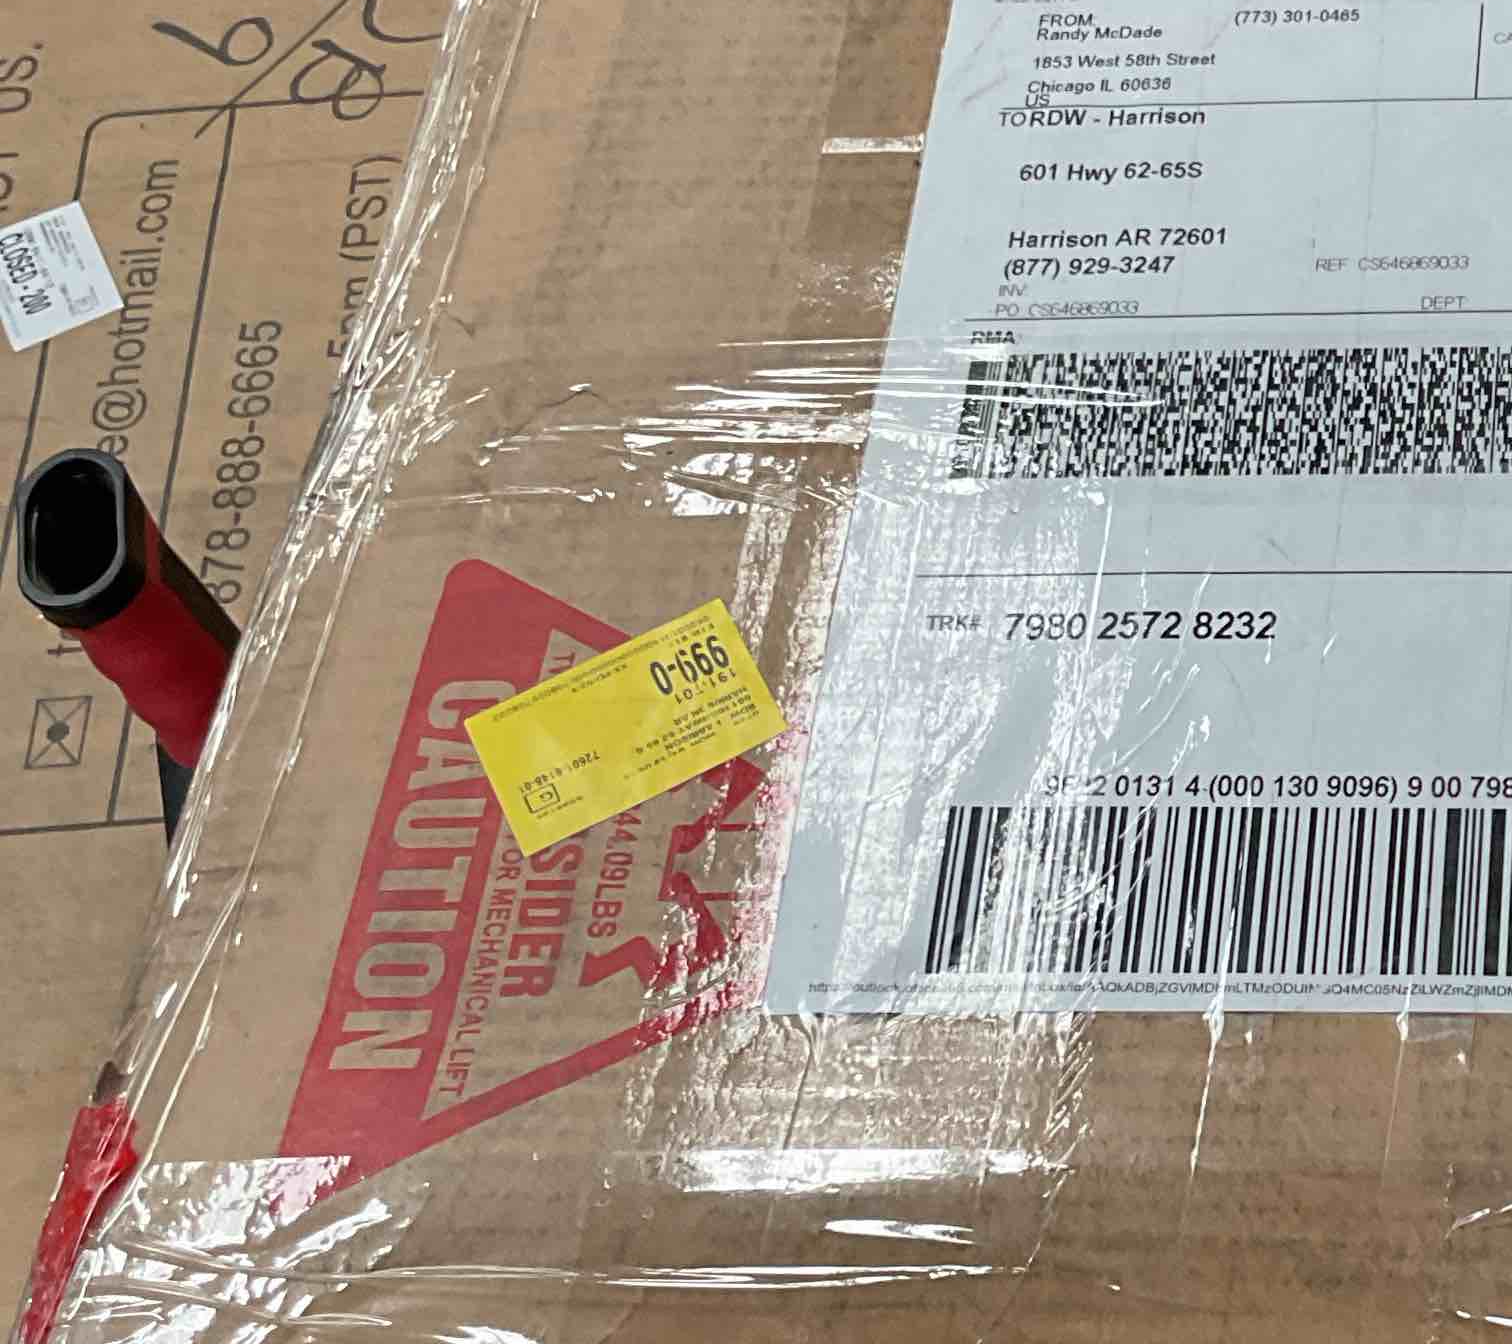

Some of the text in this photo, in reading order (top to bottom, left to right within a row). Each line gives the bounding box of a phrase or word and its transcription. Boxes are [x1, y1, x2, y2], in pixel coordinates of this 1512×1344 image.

[1234, 9, 1278, 27] (773)
[1037, 25, 1163, 42] Randy McDade
[1034, 52, 1216, 70] 1853 West 58th Street
[1027, 80, 1096, 97] Chicago
[1100, 79, 1113, 93] IL
[1025, 94, 1051, 108] US
[1029, 109, 1088, 127] RDW
[1108, 108, 1207, 127] Harrison
[1019, 161, 1204, 185] 601 Hwy 62-65S
[339, 156, 403, 262] (PST)
[1008, 227, 1228, 249] Harrison AR 72601
[1004, 255, 1176, 280] (877) 929-3247
[206, 319, 283, 604] 878-888-6665
[1003, 611, 1088, 641] 7980
[1097, 610, 1182, 641] 2572
[1193, 609, 1278, 641] 8232
[1114, 775, 1175, 797] 0131
[1185, 775, 1201, 797] 4
[1208, 774, 1265, 802] (000
[1273, 775, 1318, 797] 130
[1326, 775, 1398, 802] 9096)
[1407, 776, 1424, 799] 9
[1430, 776, 1463, 799] 00
[328, 679, 515, 1072] CAUTION
[454, 886, 514, 1044] MECHANICAL
[439, 1046, 477, 1097] LIFT
